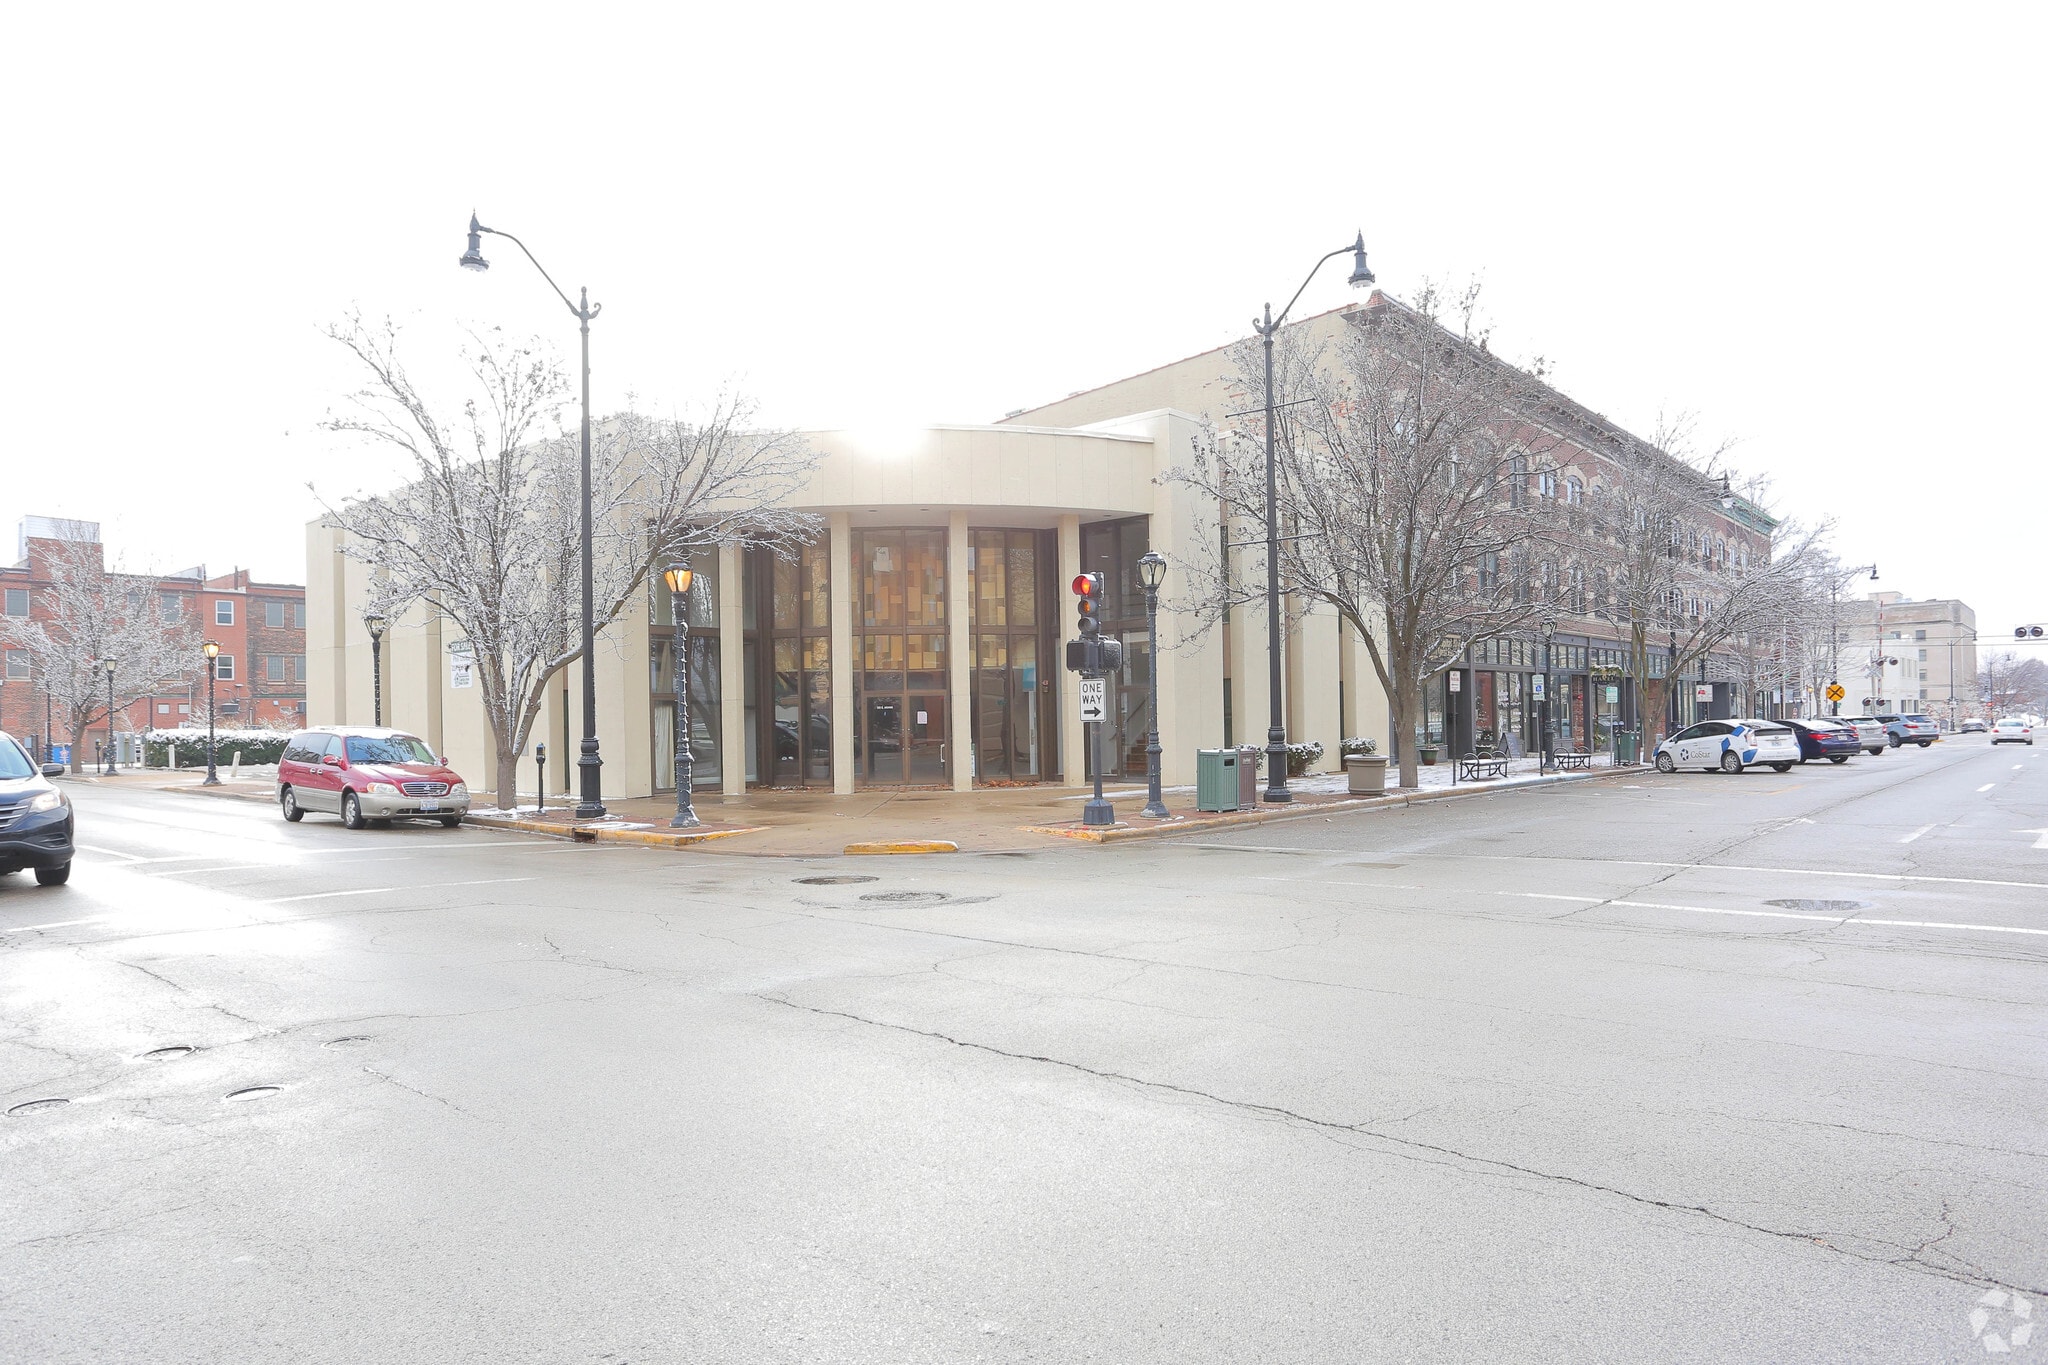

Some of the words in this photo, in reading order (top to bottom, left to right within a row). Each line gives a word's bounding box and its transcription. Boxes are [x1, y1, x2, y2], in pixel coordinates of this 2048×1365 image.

[1082, 683, 1102, 693] ONE
[1082, 695, 1102, 704] WAY
[1690, 750, 1710, 759] CoStar
